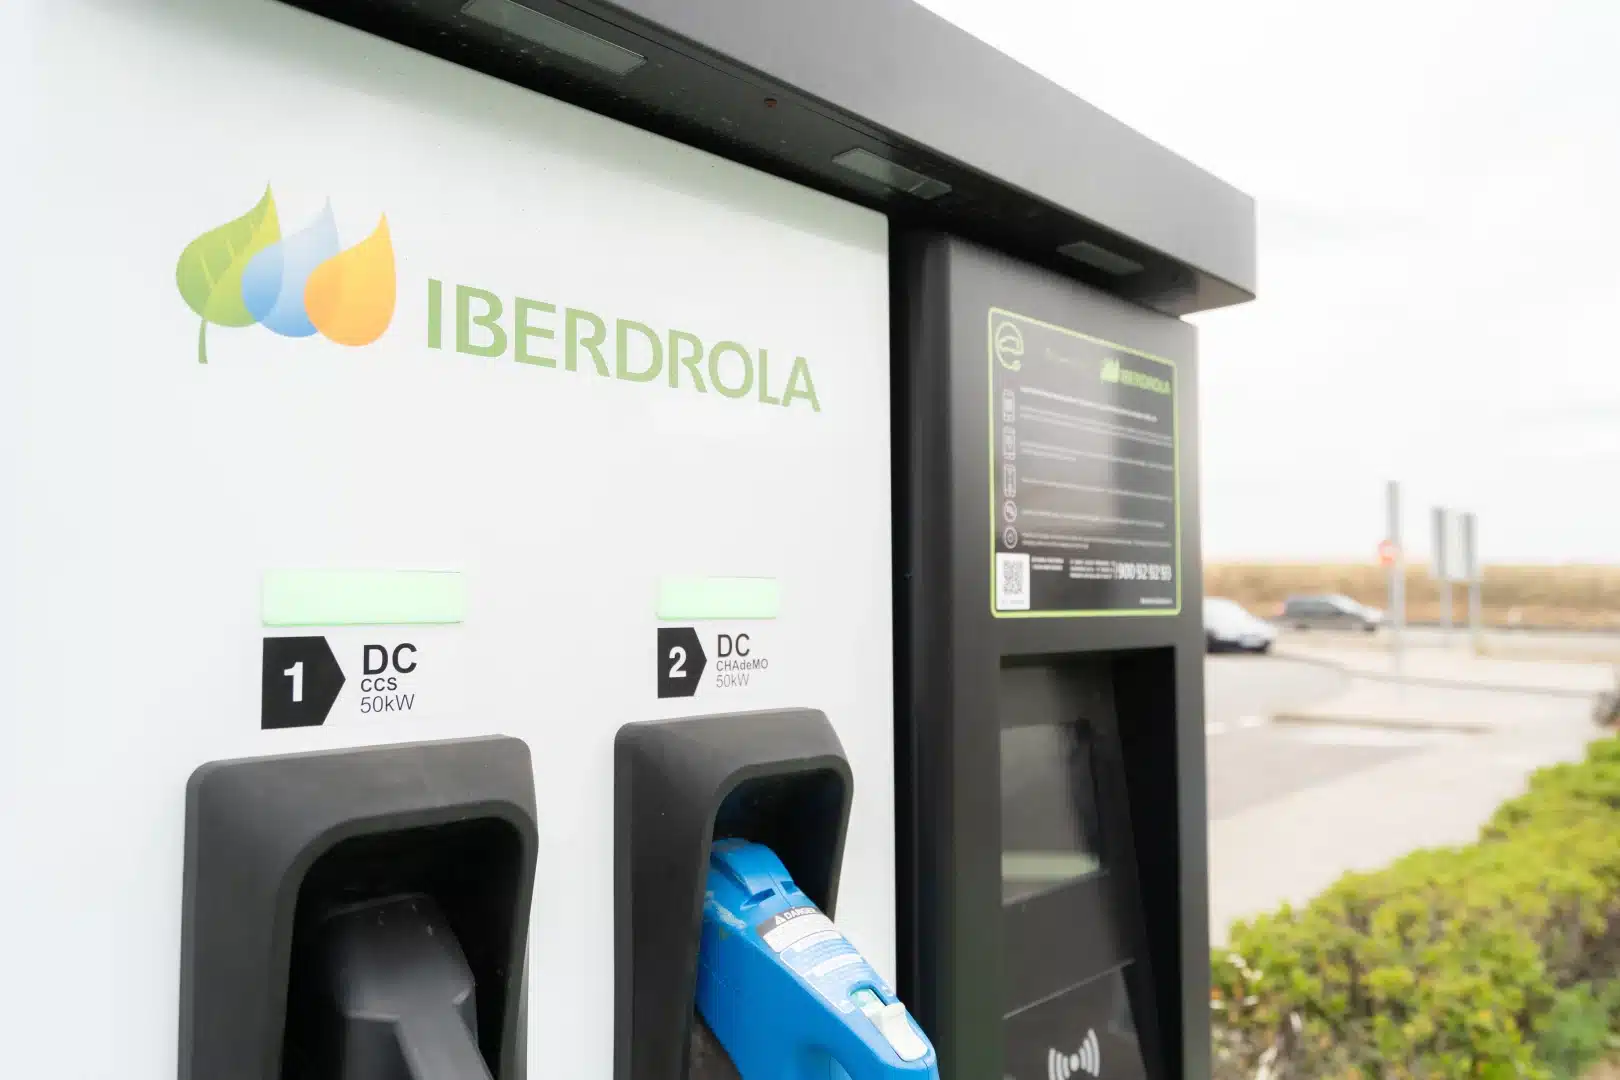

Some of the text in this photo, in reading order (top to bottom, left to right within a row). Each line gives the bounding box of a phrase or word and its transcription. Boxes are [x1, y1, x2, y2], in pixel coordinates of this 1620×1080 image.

[427, 277, 821, 412] IBERDROLA
[363, 642, 417, 675] DC
[717, 633, 750, 658] DC
[668, 646, 687, 678] 2
[716, 658, 769, 672] CHAdeMO
[283, 661, 304, 702] 1
[716, 673, 750, 688] 50kW
[360, 694, 415, 713] 50kW
